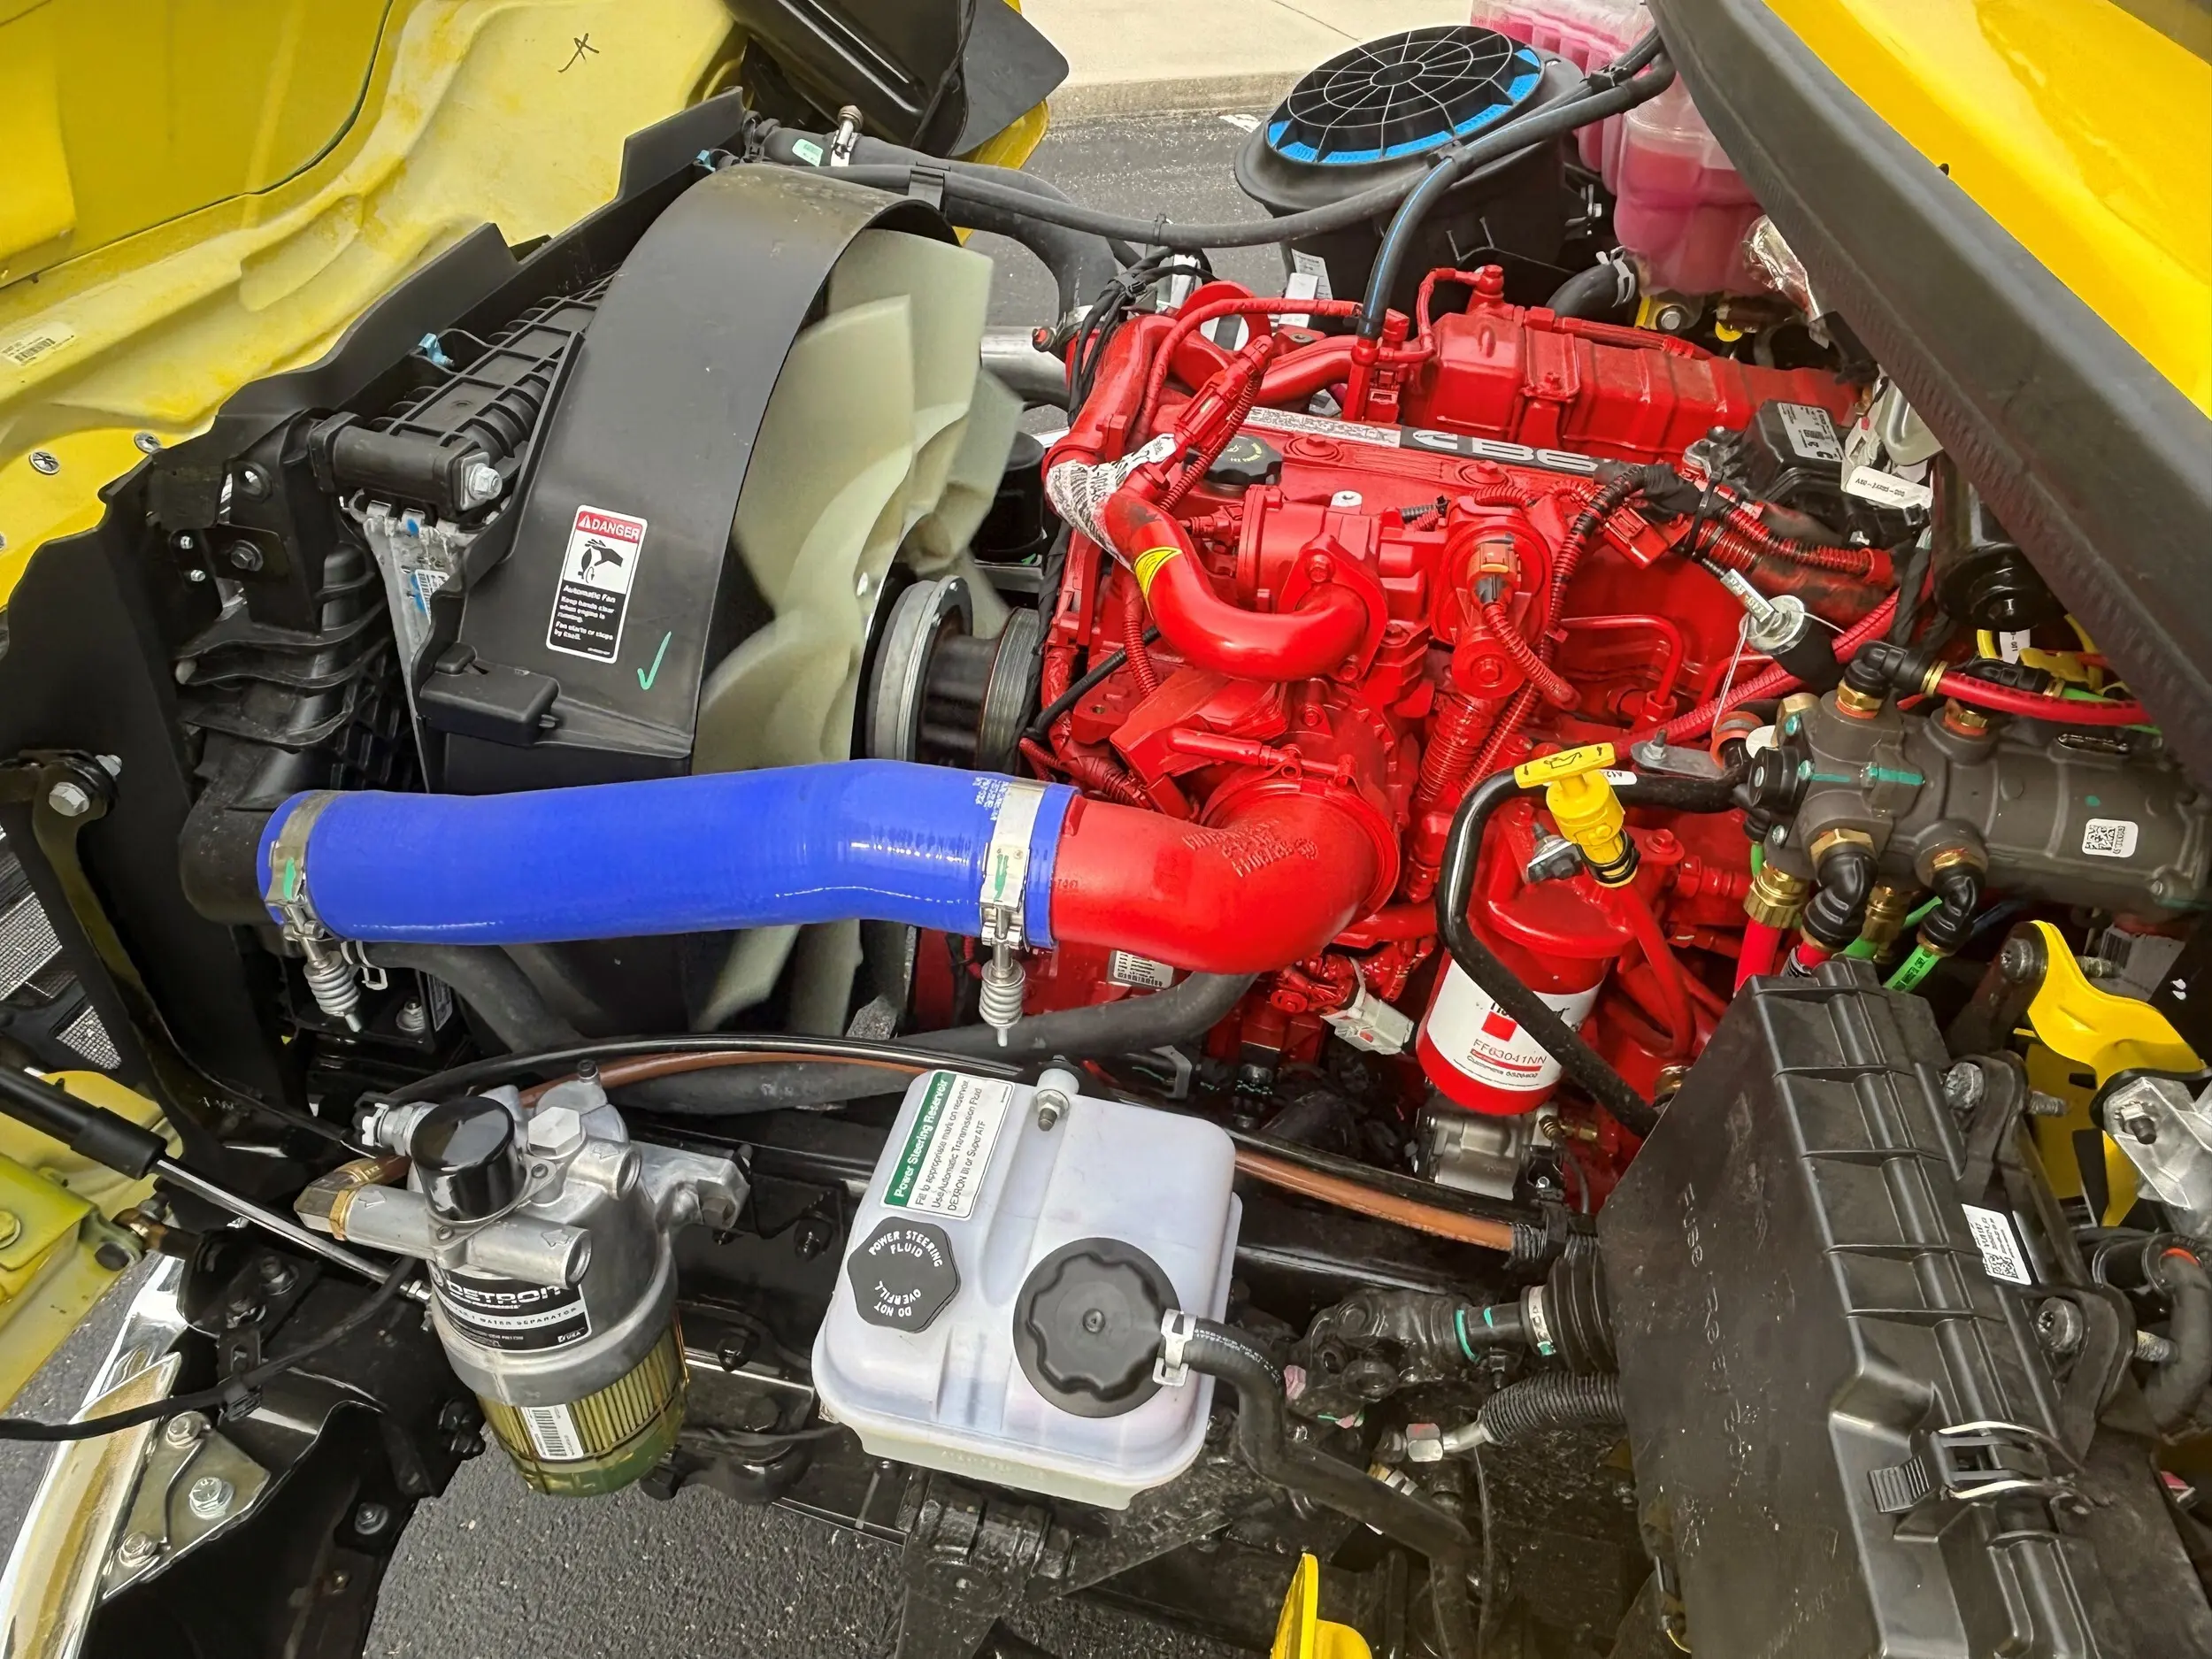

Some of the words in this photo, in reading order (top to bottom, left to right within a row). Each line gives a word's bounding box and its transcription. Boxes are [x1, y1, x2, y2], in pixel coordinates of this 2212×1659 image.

[1471, 437, 1600, 472] B6
[591, 518, 641, 541] DANGER
[563, 584, 602, 600] Automatic
[1472, 1038, 1548, 1064] FF63041NN
[894, 1165, 914, 1198] Power
[907, 1123, 934, 1164] Steering
[924, 1079, 949, 1124] Reservoir
[977, 1120, 987, 1136] ATF
[915, 1192, 927, 1206] Fill
[927, 1141, 948, 1184] appropriate
[942, 1122, 954, 1141] mark
[950, 1111, 957, 1122] on
[932, 1190, 944, 1209] Use
[940, 1153, 958, 1194] Automatic
[951, 1105, 977, 1154] Transmission
[971, 1087, 983, 1107] Fluid
[967, 1134, 981, 1158] Super
[965, 1157, 973, 1167] or
[948, 1175, 967, 1211] DEXRON
[868, 1230, 901, 1256] POWER
[905, 1229, 943, 1268] STEERING
[889, 1242, 923, 1258] FLUID
[446, 1279, 562, 1304] DETROIT
[874, 1279, 922, 1306] OVERFILL
[873, 1301, 895, 1317] NOT
[897, 1306, 912, 1317] DO
